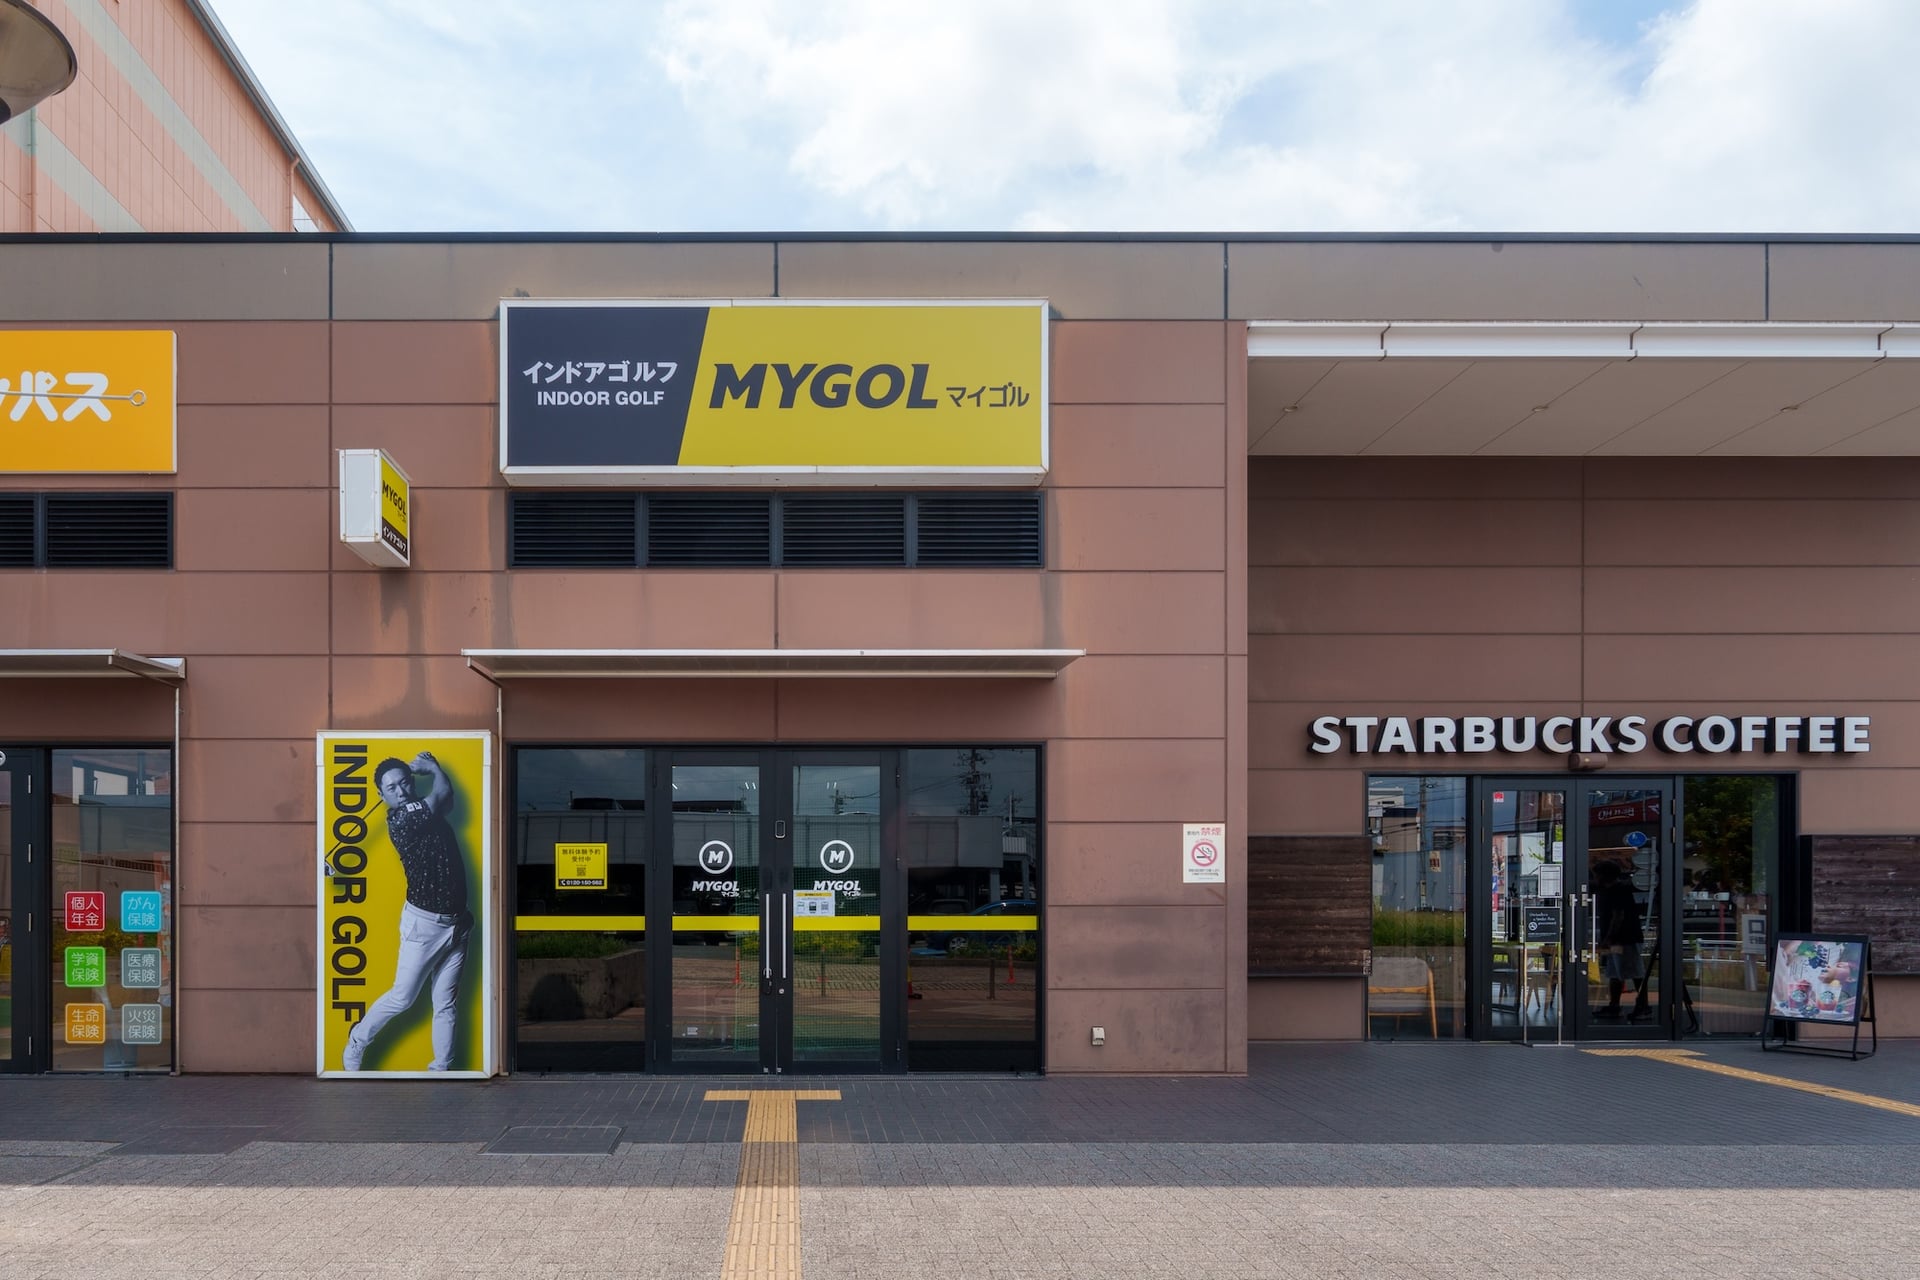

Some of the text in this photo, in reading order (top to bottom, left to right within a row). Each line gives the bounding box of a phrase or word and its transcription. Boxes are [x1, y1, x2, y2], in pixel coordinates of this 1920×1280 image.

[523, 360, 678, 384] インドアゴルフ
[708, 363, 938, 409] MYGOL
[537, 390, 665, 406] INDOOR GOLF
[946, 381, 1030, 408] マイゴル
[381, 480, 407, 516] MYGOL
[1311, 715, 1871, 754] STARBUCKS COFFEE
[708, 850, 724, 864] M
[829, 850, 845, 864] M
[332, 744, 368, 1038] INDOOR GOLF
[691, 880, 740, 892] MYGOL
[813, 880, 861, 891] MYGOL
[71, 896, 99, 910] 個人
[127, 897, 156, 911] がん
[71, 912, 99, 926] 年金
[127, 912, 156, 926] 保険
[71, 952, 99, 966] 学資
[127, 953, 156, 967] 医療
[71, 967, 100, 982] 保険
[127, 968, 156, 983] 保険
[71, 1008, 100, 1023] 生命
[127, 1009, 156, 1023] 火災
[71, 1024, 100, 1039] 保険
[127, 1025, 156, 1039] 保険
